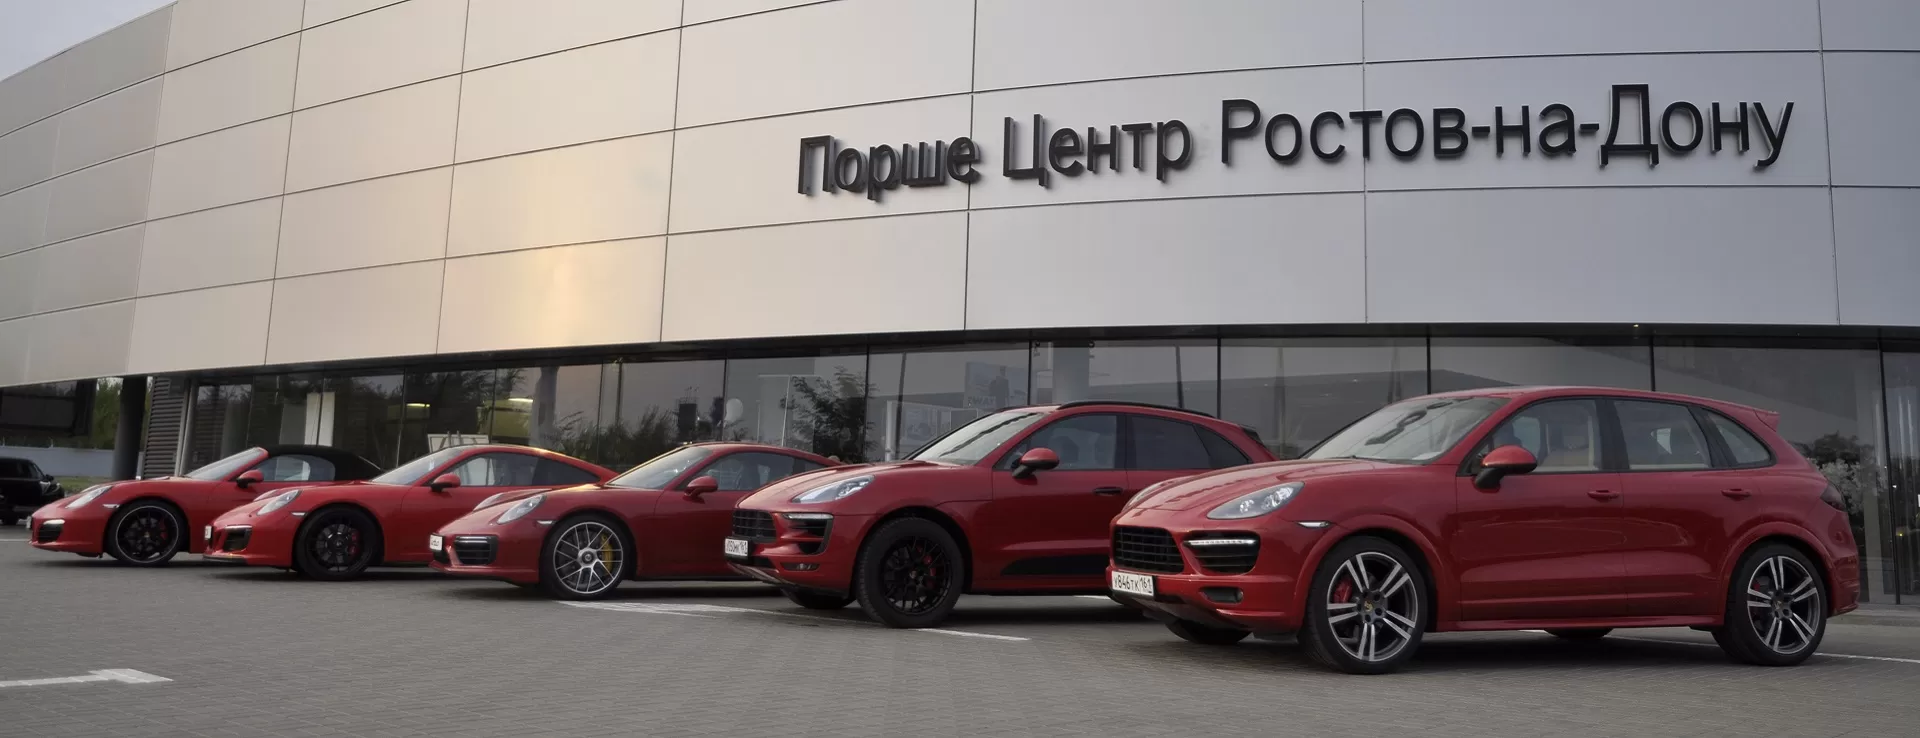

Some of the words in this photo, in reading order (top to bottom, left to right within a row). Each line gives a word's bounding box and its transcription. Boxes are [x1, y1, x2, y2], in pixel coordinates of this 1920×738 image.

[798, 135, 980, 202] Порше
[1003, 113, 1193, 188] Центр
[1221, 84, 1794, 167] Ростов-на-Дону
